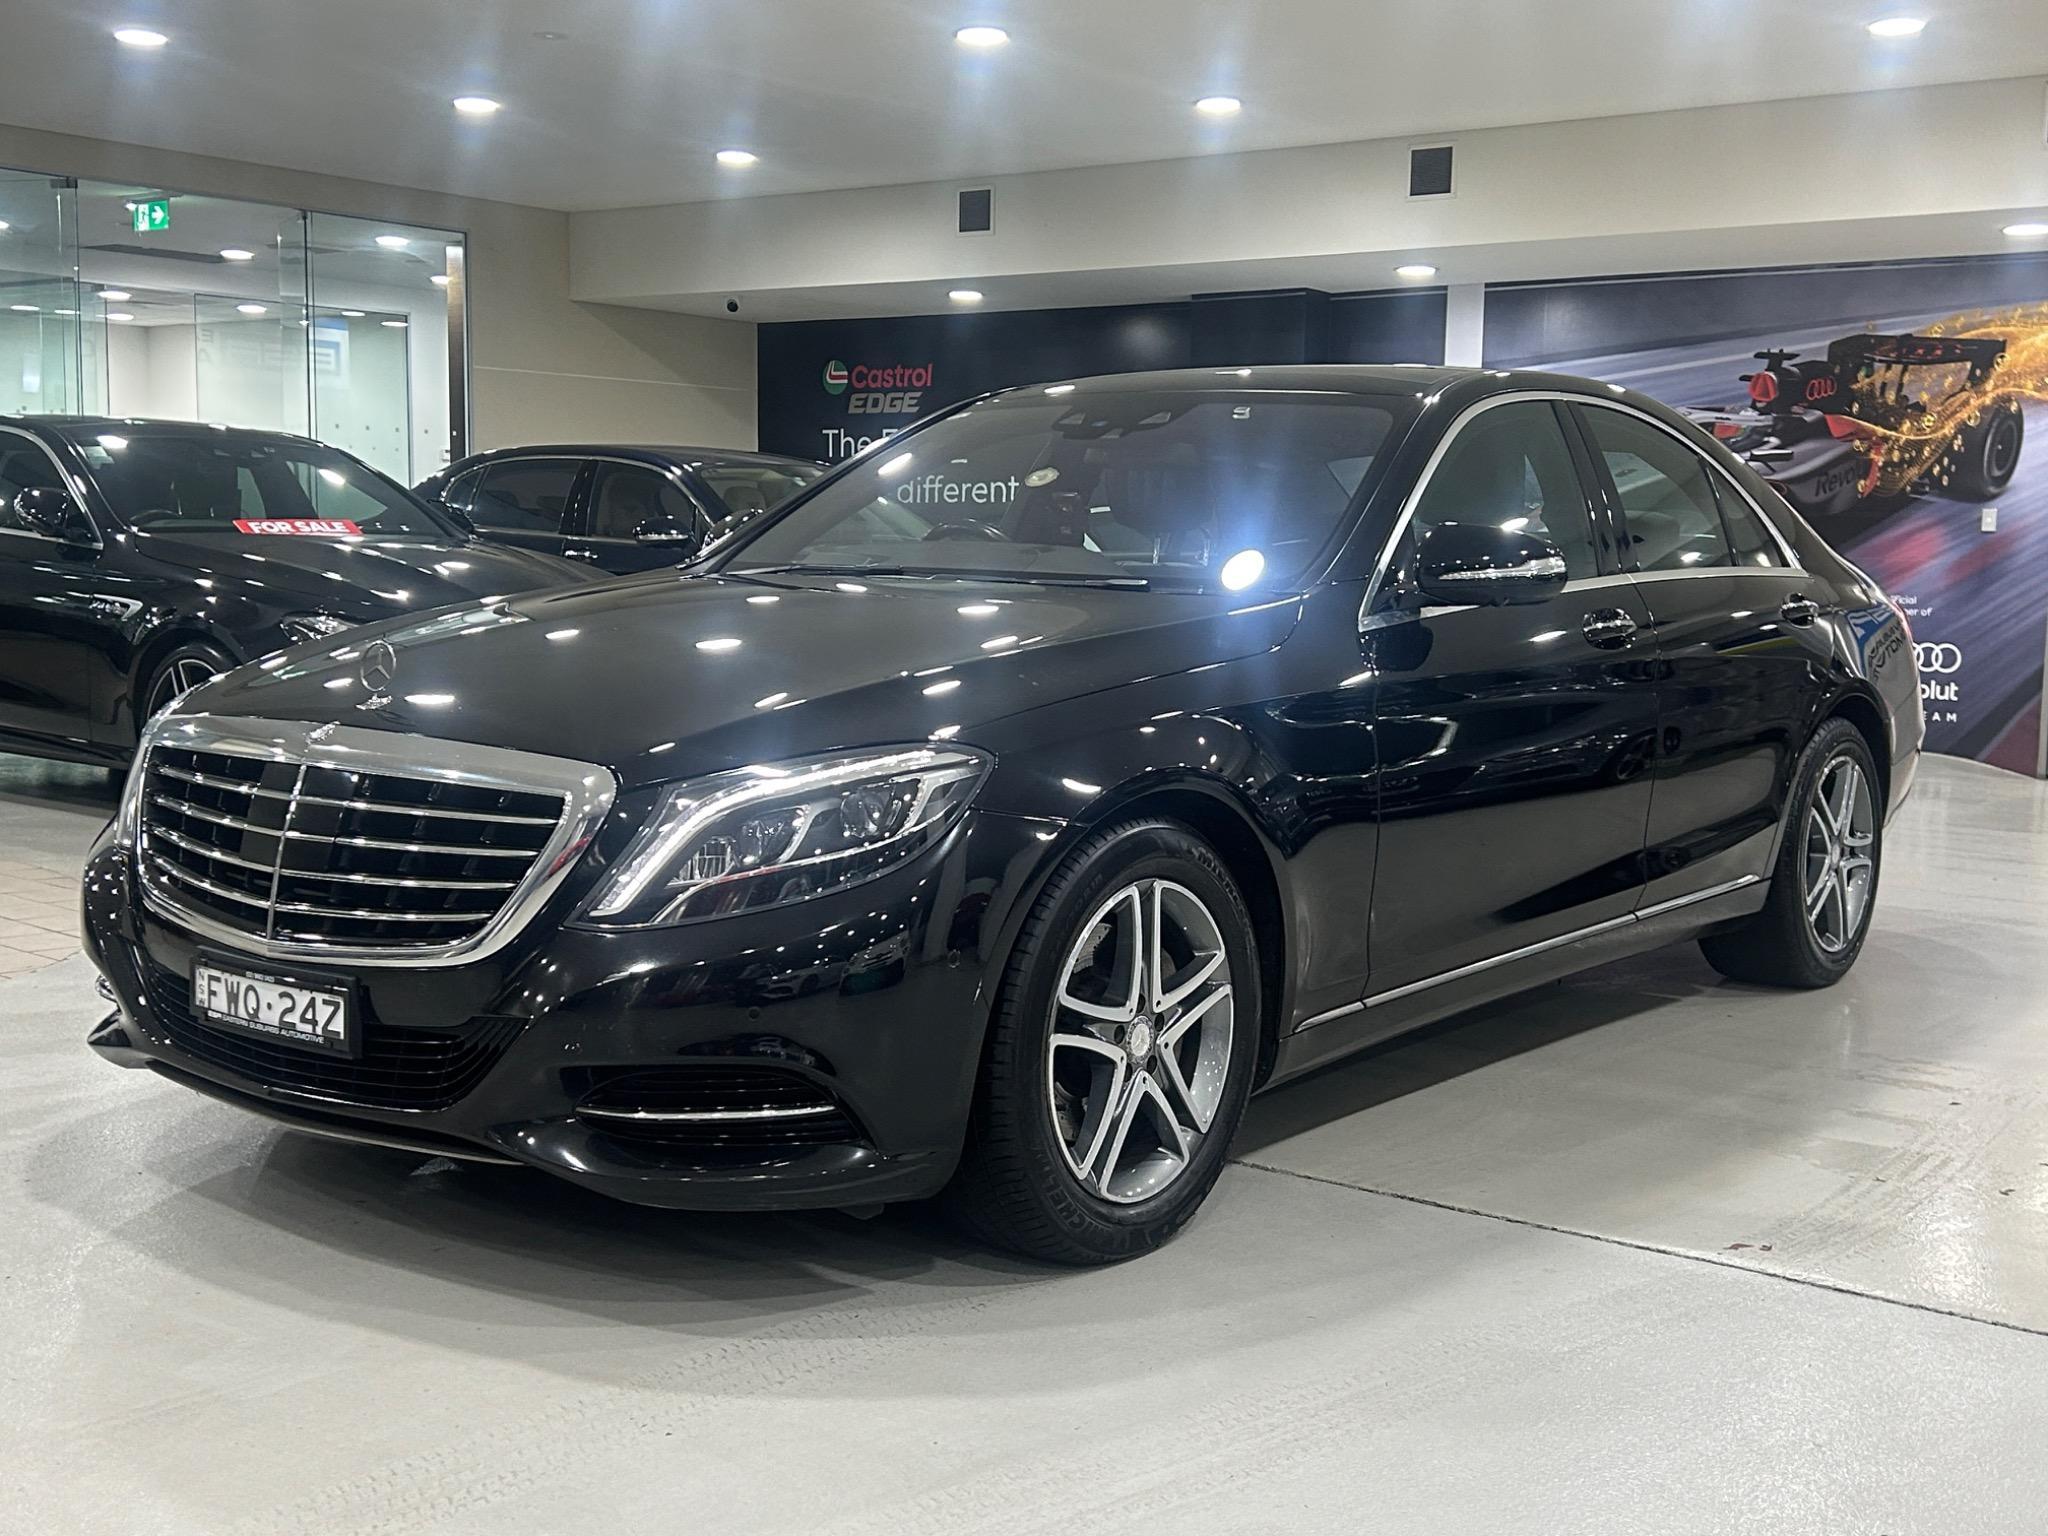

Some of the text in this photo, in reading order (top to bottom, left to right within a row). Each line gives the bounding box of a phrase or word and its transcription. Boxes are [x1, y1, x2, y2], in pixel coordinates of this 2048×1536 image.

[851, 363, 933, 389] Castrol
[848, 391, 923, 414] EDGE
[822, 428, 872, 458] The
[896, 475, 1020, 504] different
[246, 521, 351, 534] FOR SALE
[1920, 606, 1933, 617] of
[280, 1029, 325, 1044] AUTOMOTIVE
